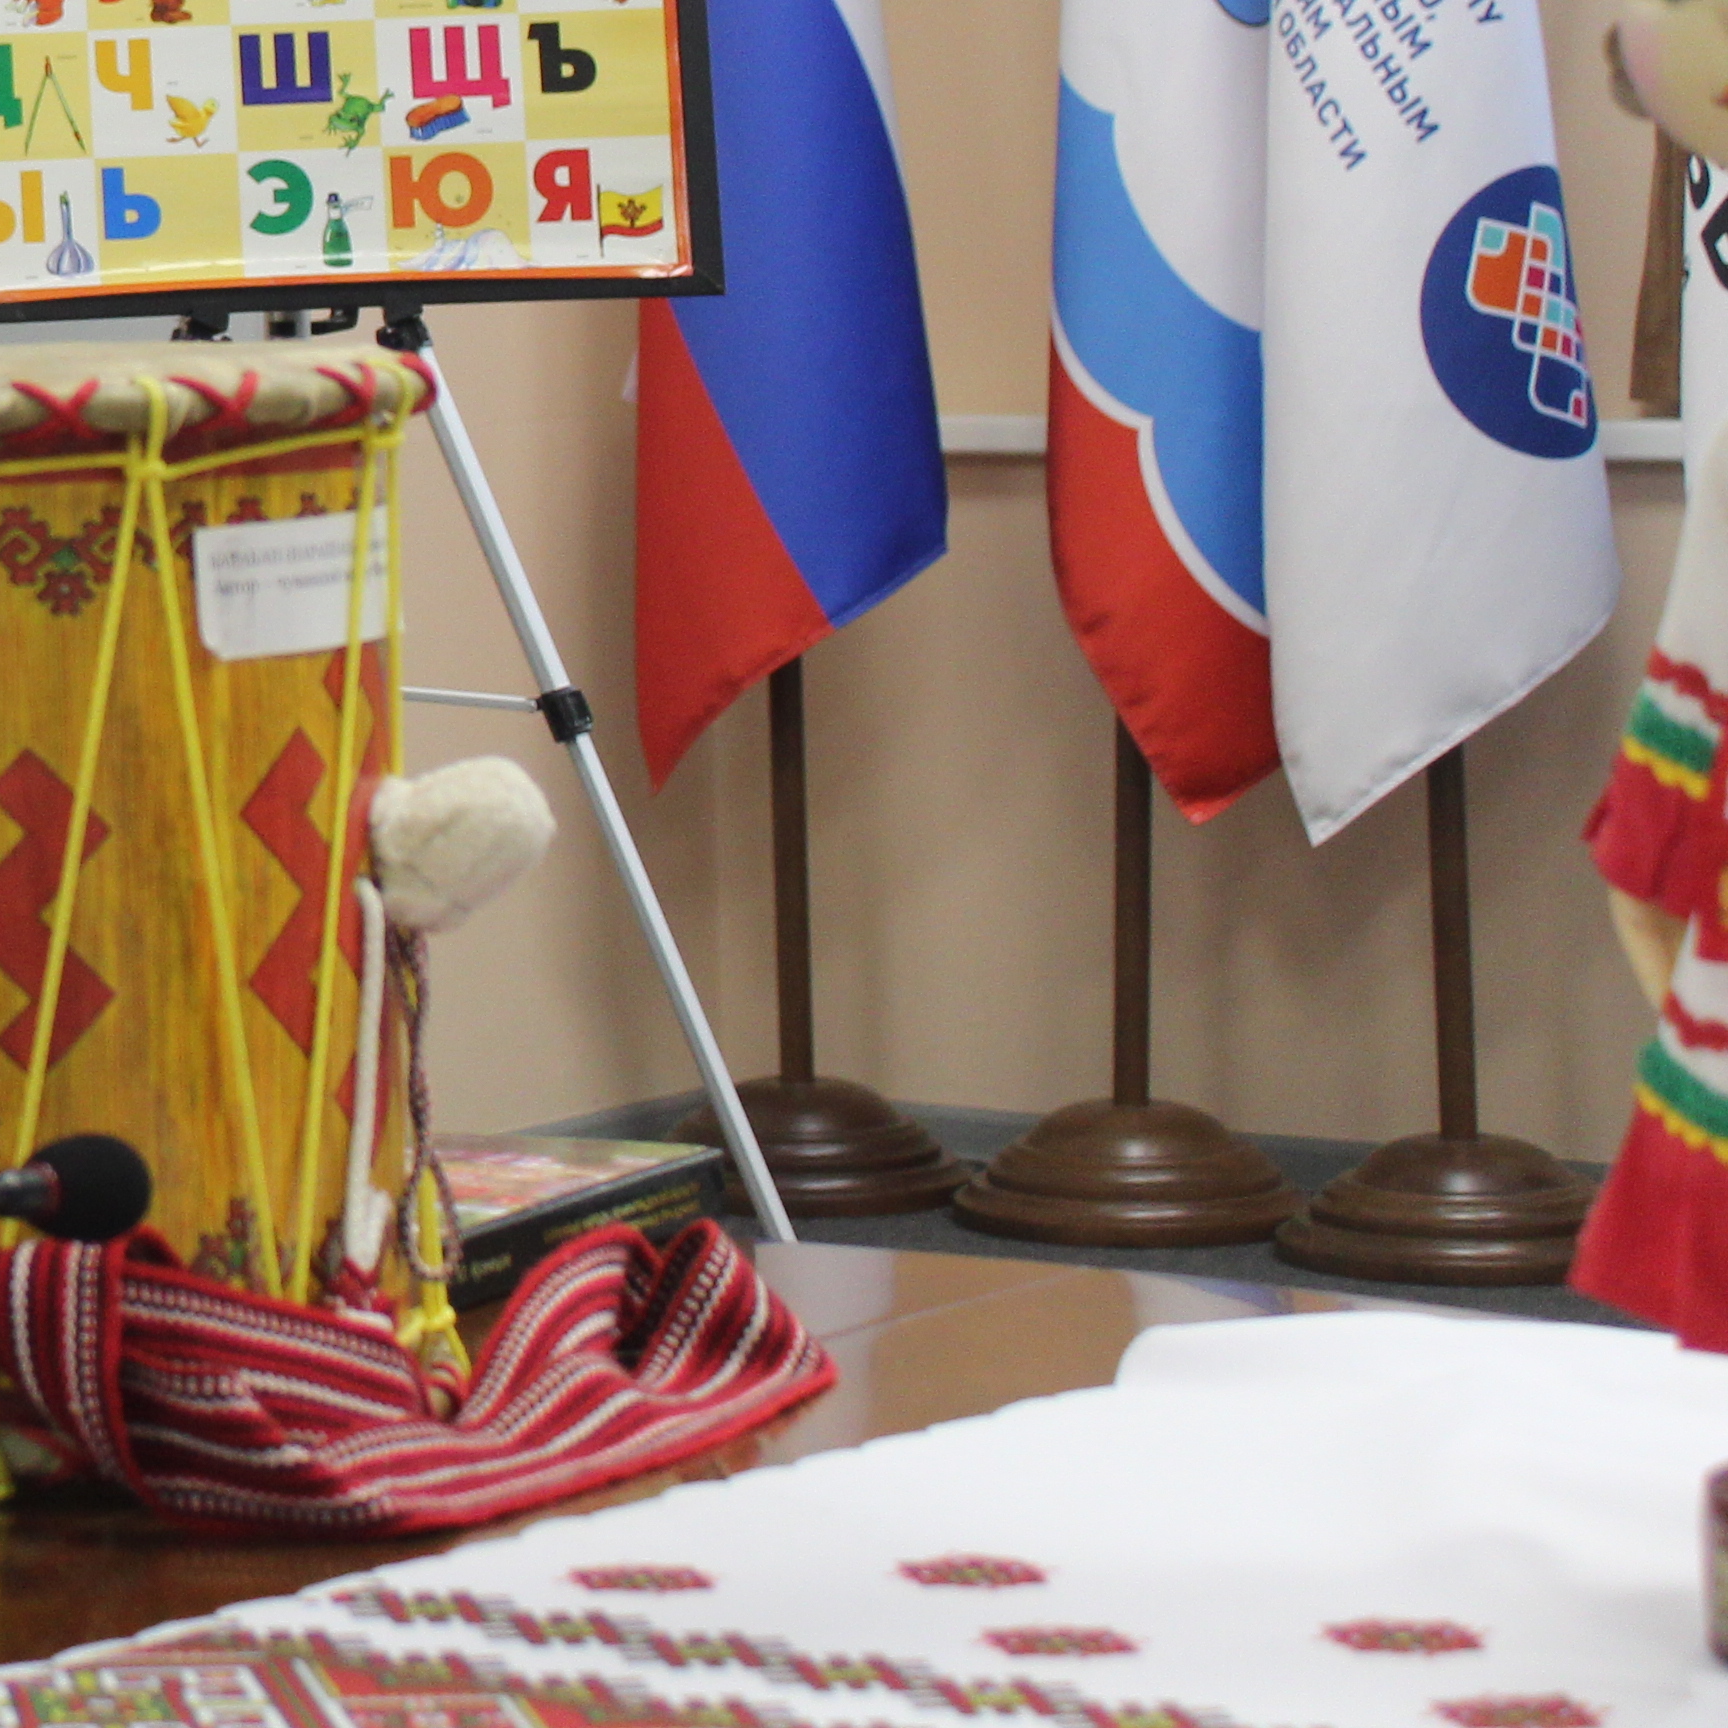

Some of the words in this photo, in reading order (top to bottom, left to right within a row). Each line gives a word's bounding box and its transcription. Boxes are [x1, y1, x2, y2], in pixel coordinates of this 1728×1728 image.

[94, 39, 154, 111] Ч
[239, 32, 332, 106] Ш
[409, 25, 509, 109] Щ
[527, 22, 597, 93] Ъ
[1279, 12, 1368, 171] ОБЛАСТИ
[101, 168, 161, 241] Ь
[248, 160, 313, 234] Э
[390, 152, 493, 229] Ю
[533, 149, 593, 223] Я
